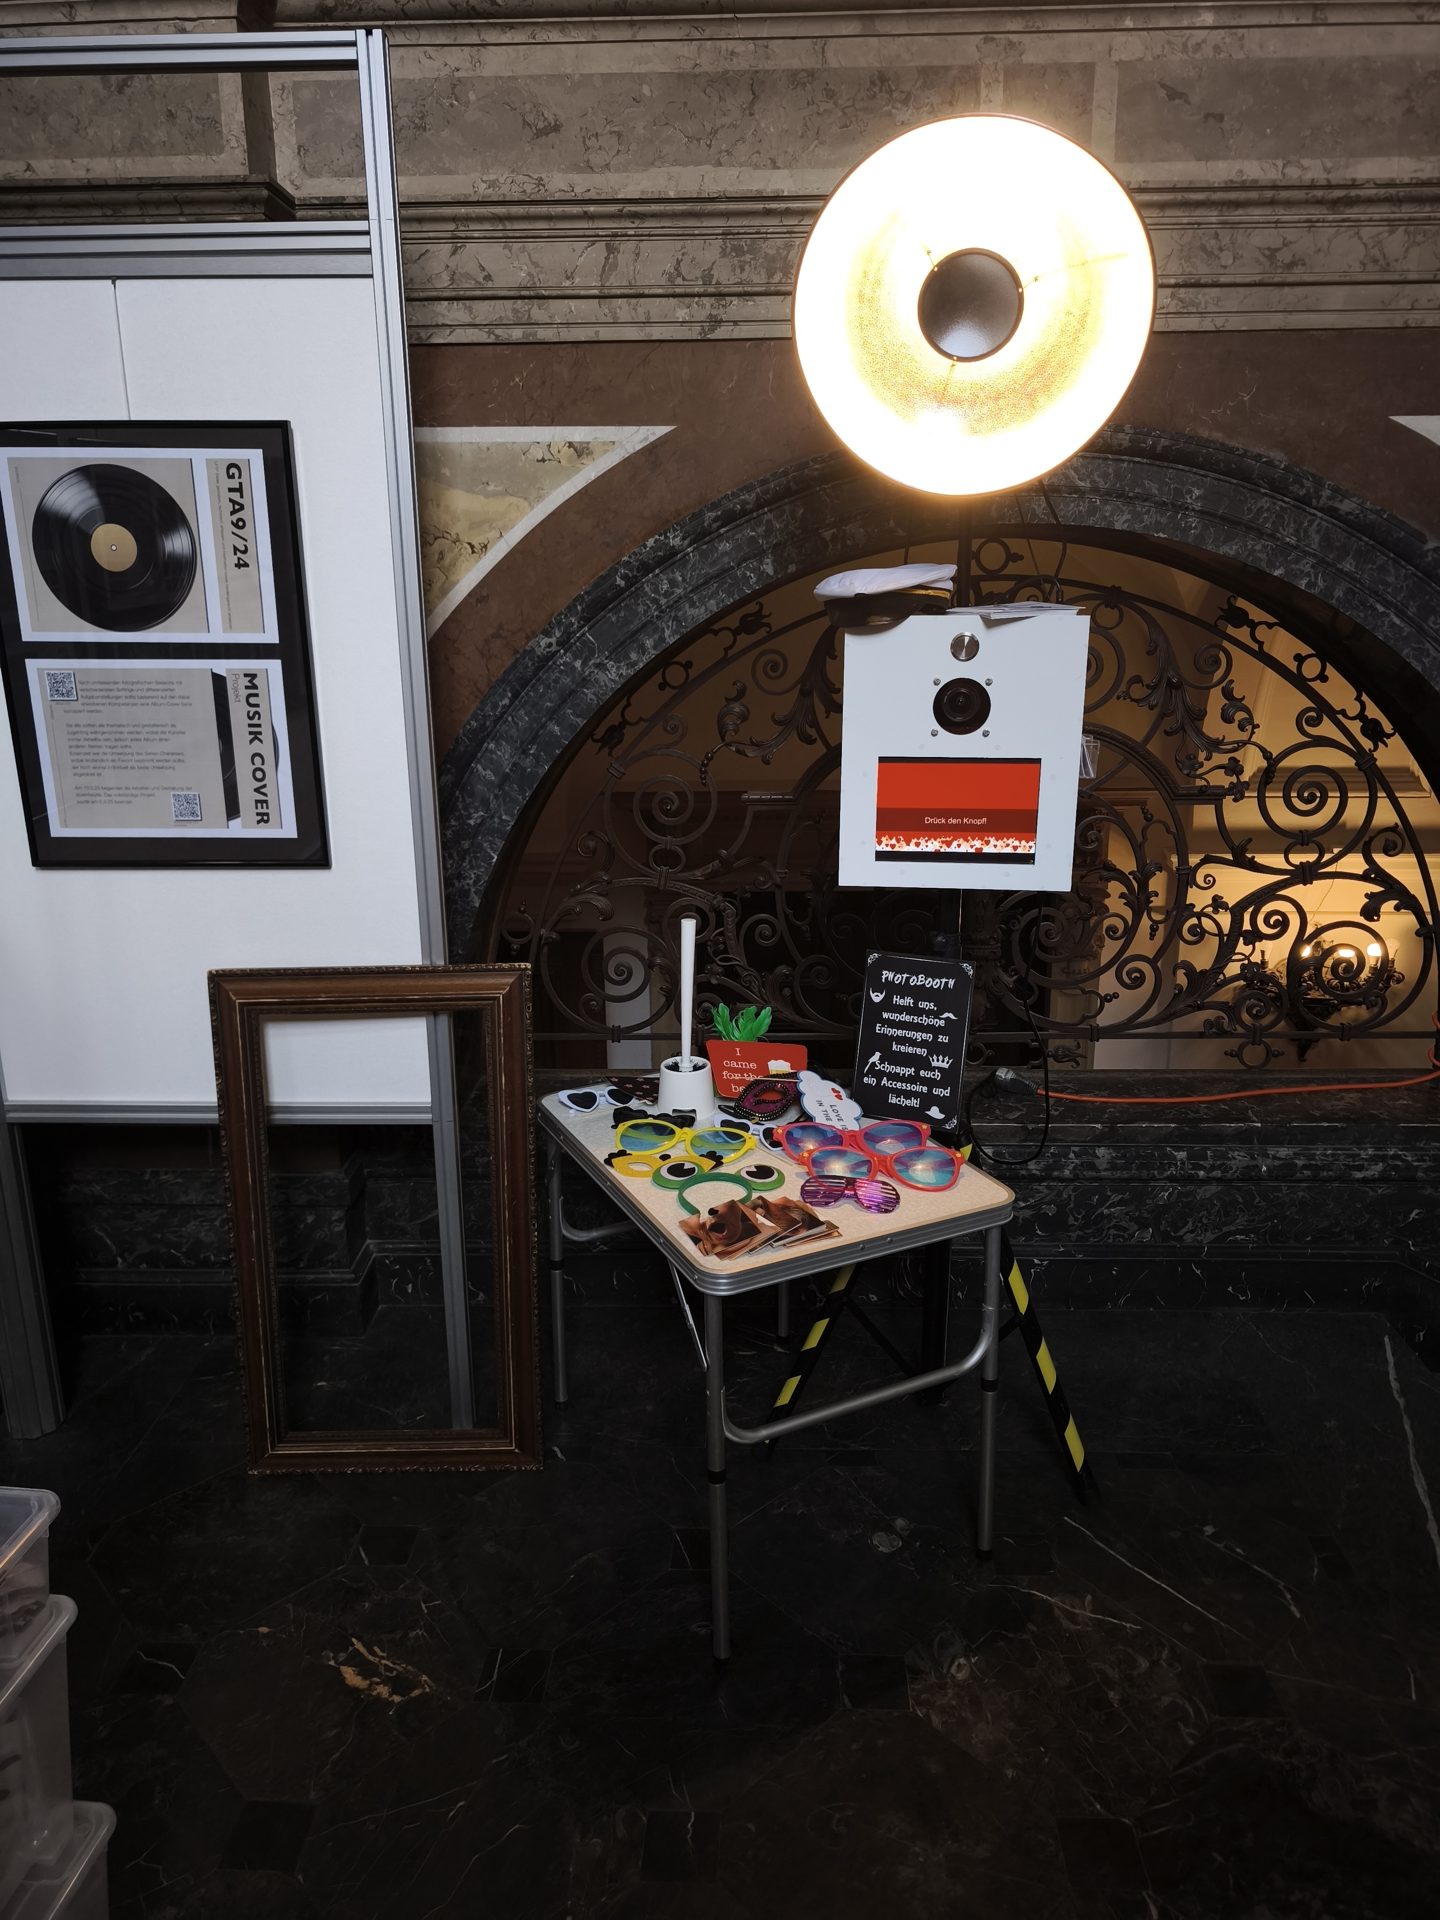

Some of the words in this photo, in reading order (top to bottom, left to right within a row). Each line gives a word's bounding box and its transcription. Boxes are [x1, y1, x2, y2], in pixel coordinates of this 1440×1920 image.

[225, 462, 250, 570] GTA9/24
[231, 673, 241, 703] Projekt
[243, 673, 263, 746] MUSIK
[250, 752, 271, 825] COVER
[924, 816, 946, 824] Drück
[947, 817, 962, 825] den
[881, 970, 956, 990] PHOTOBOOTH
[892, 994, 914, 1007] Helft
[881, 1011, 946, 1027] wunderschöne
[875, 1023, 933, 1042] Erinnerungen
[937, 1034, 949, 1043] zu
[892, 1041, 928, 1057] kreieren
[723, 1060, 757, 1070] came
[874, 1060, 915, 1077] Schnappt
[919, 1069, 941, 1081] euch
[722, 1070, 741, 1080] for
[863, 1074, 877, 1087] ein
[880, 1076, 928, 1093] Accessoire
[932, 1086, 951, 1097] und
[888, 1093, 920, 1108] lächelt!
[821, 1109, 833, 1122] THE
[829, 1104, 844, 1122] LOVE
